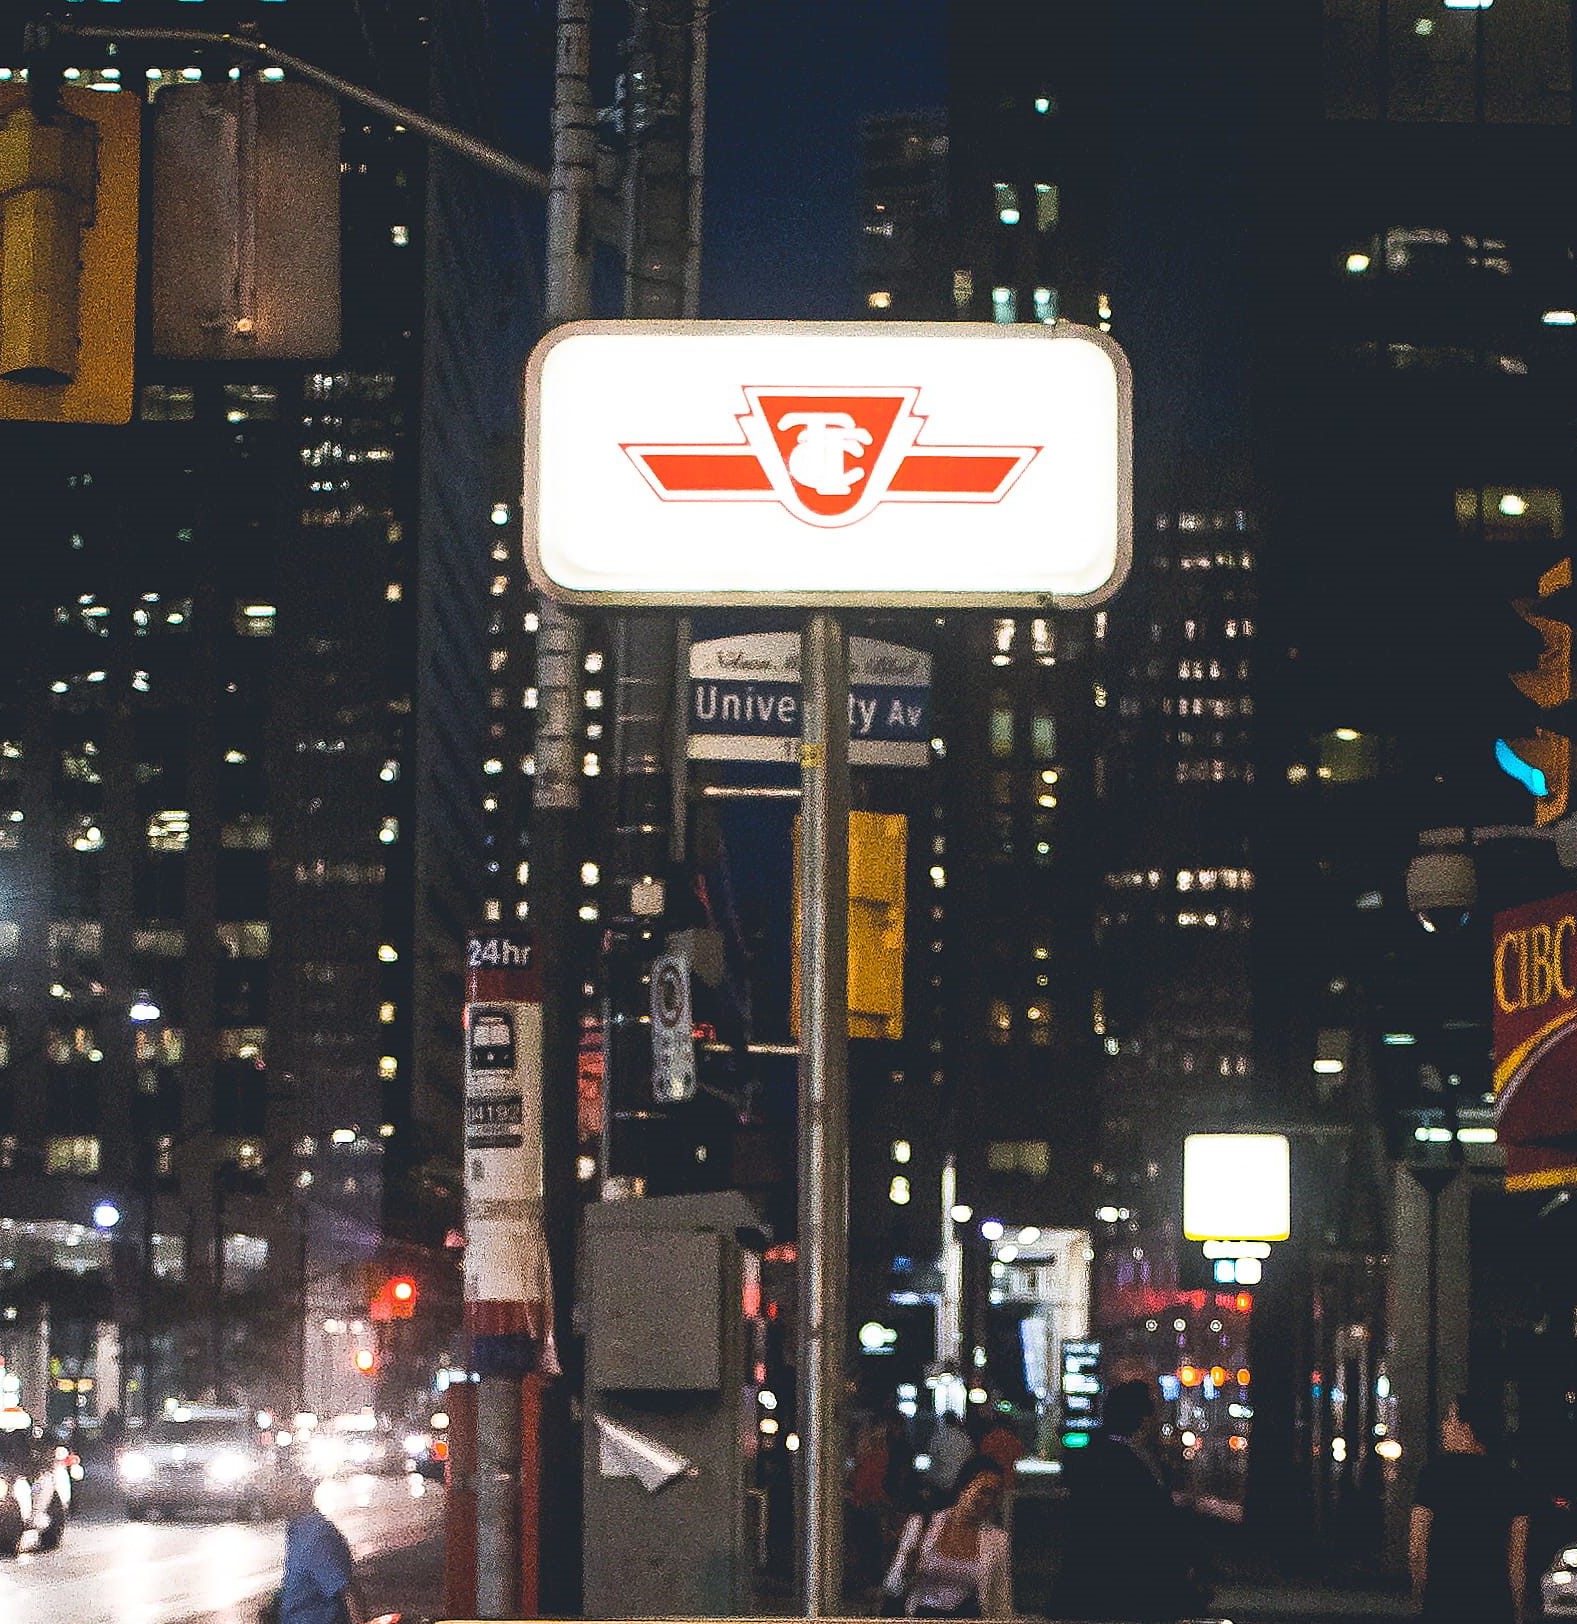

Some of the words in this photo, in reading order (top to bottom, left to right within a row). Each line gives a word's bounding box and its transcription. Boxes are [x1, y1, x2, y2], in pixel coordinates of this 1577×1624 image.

[695, 685, 877, 735] Univety
[887, 699, 923, 728] Av
[468, 937, 532, 967] 24hr
